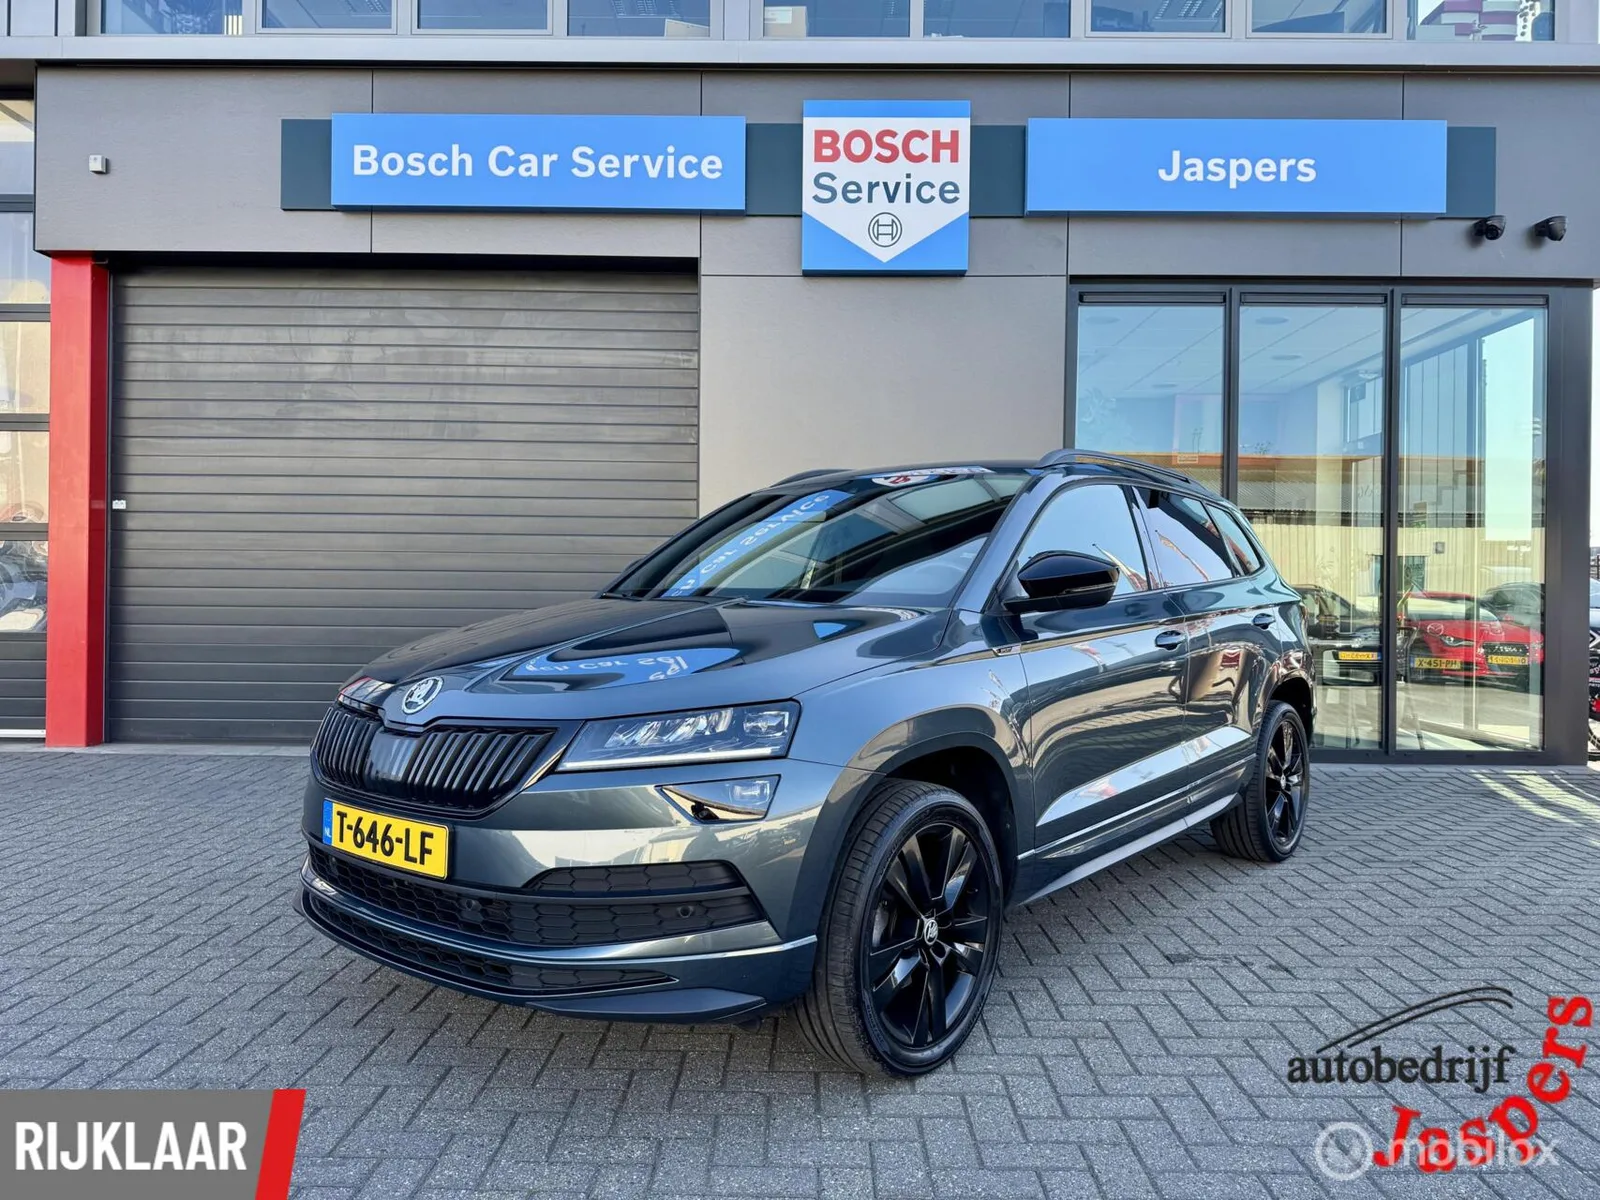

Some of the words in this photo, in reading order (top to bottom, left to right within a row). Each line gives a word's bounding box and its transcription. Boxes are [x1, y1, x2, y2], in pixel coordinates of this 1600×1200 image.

[352, 143, 473, 176] Bosch
[488, 145, 558, 177] Car
[571, 145, 723, 179] Service
[813, 129, 960, 164] BOSCH
[1158, 150, 1317, 189] Jaspers
[812, 171, 961, 205] Service
[336, 810, 434, 866] T-646-LF
